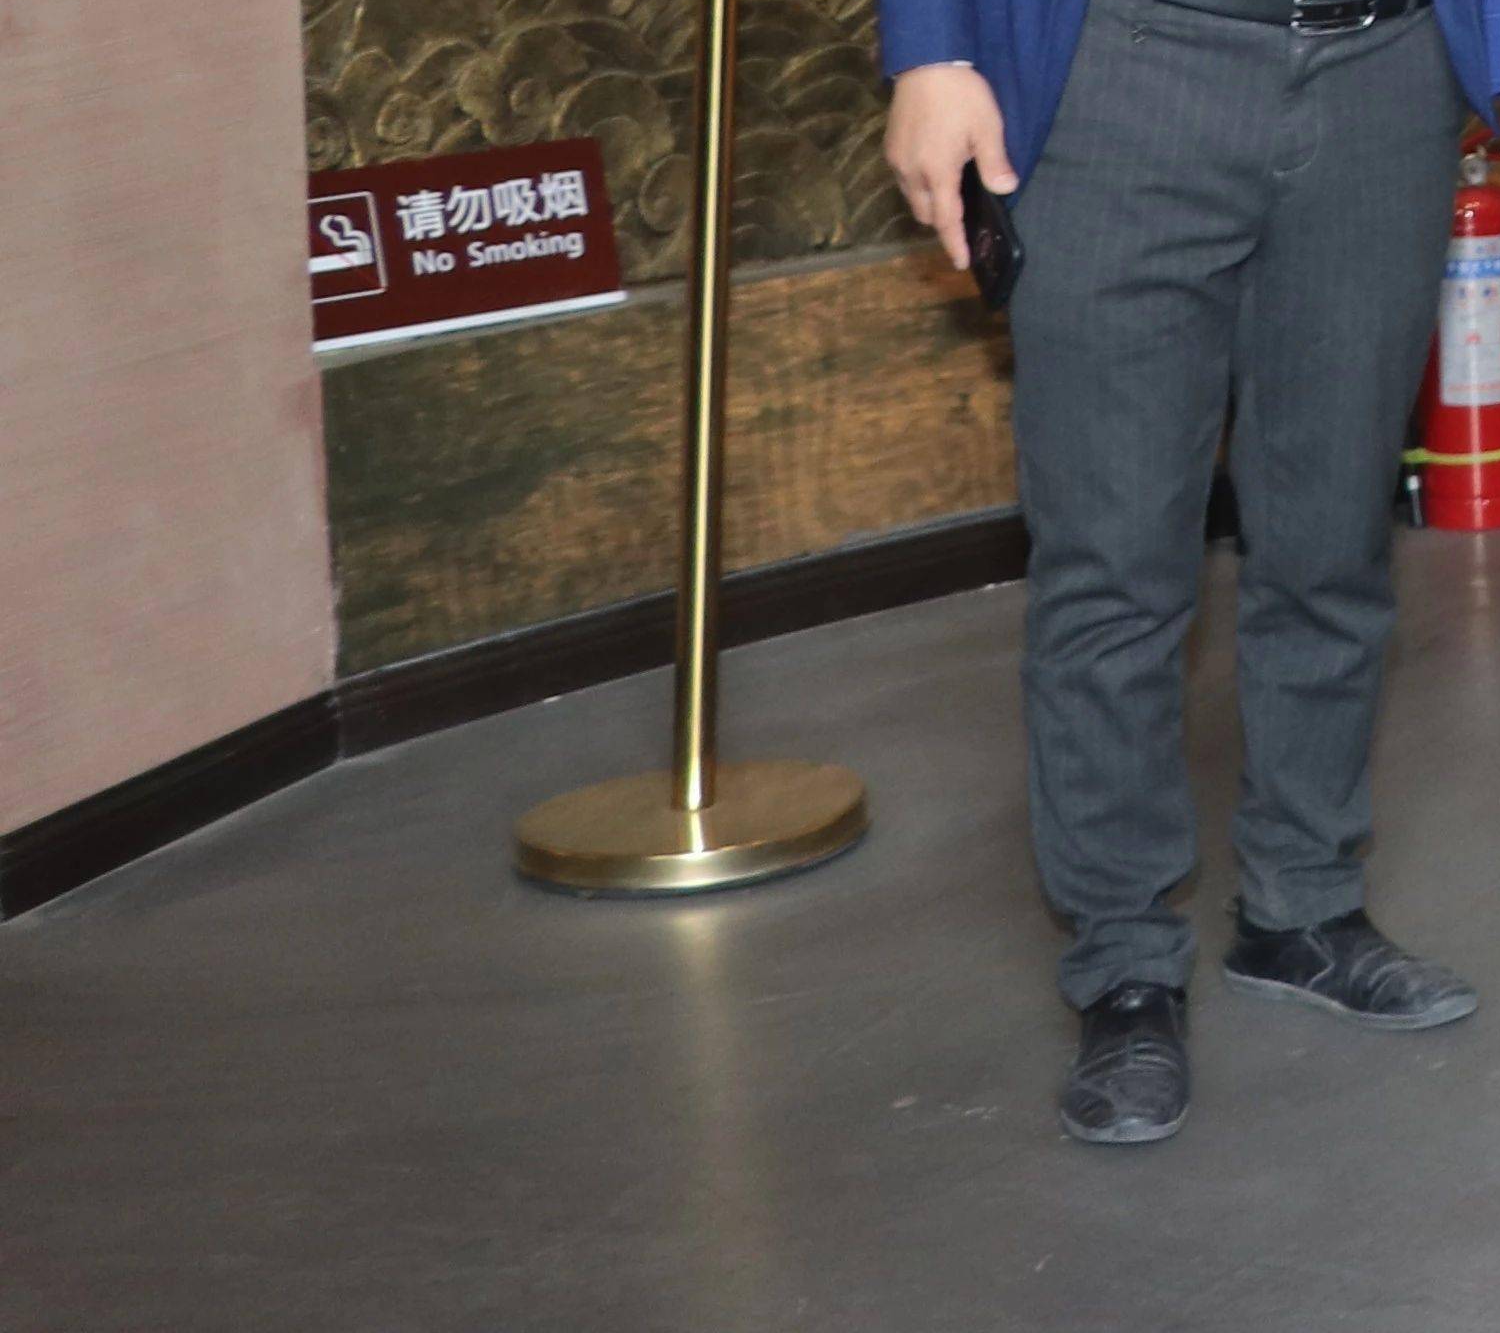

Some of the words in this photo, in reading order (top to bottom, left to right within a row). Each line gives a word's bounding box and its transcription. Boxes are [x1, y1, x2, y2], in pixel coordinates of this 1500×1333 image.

[396, 169, 590, 242] 请勿吸烟
[412, 249, 456, 277] No
[466, 229, 586, 269] Smoking
